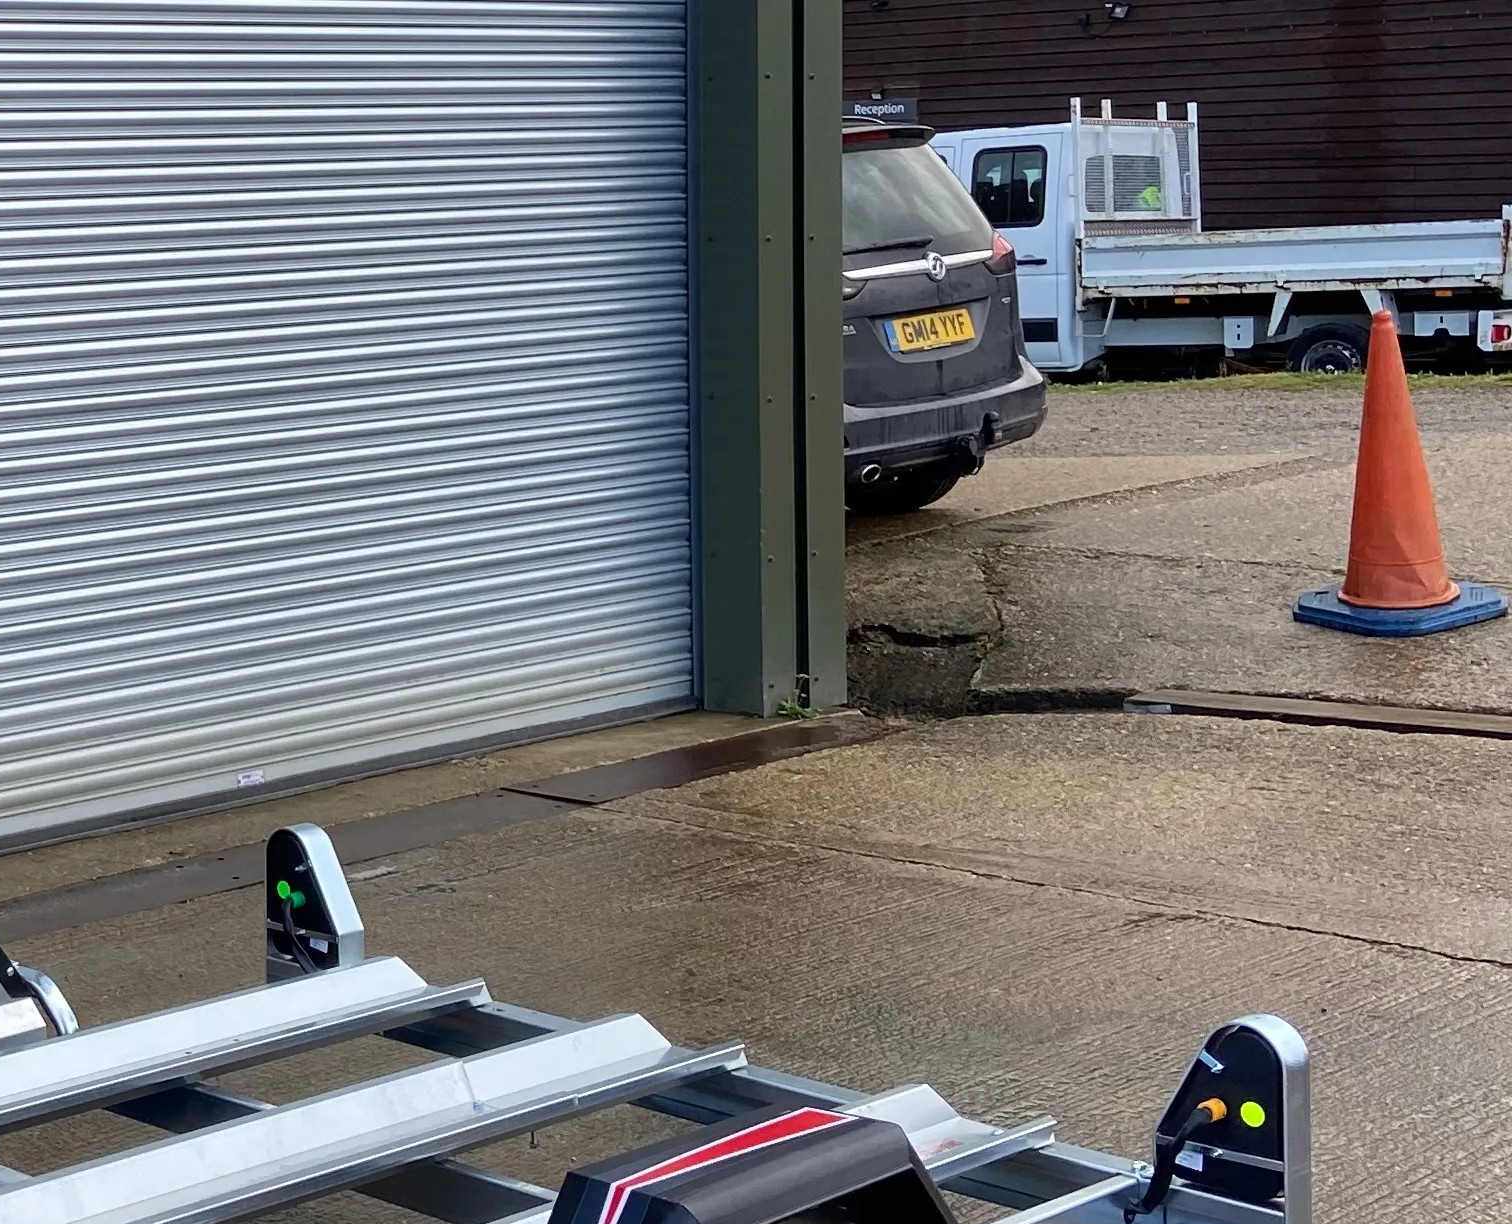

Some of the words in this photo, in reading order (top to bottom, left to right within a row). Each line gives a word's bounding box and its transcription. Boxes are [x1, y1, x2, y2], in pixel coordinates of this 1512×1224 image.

[854, 103, 905, 117] Reception
[901, 317, 940, 343] GM14
[938, 313, 965, 337] YYF
